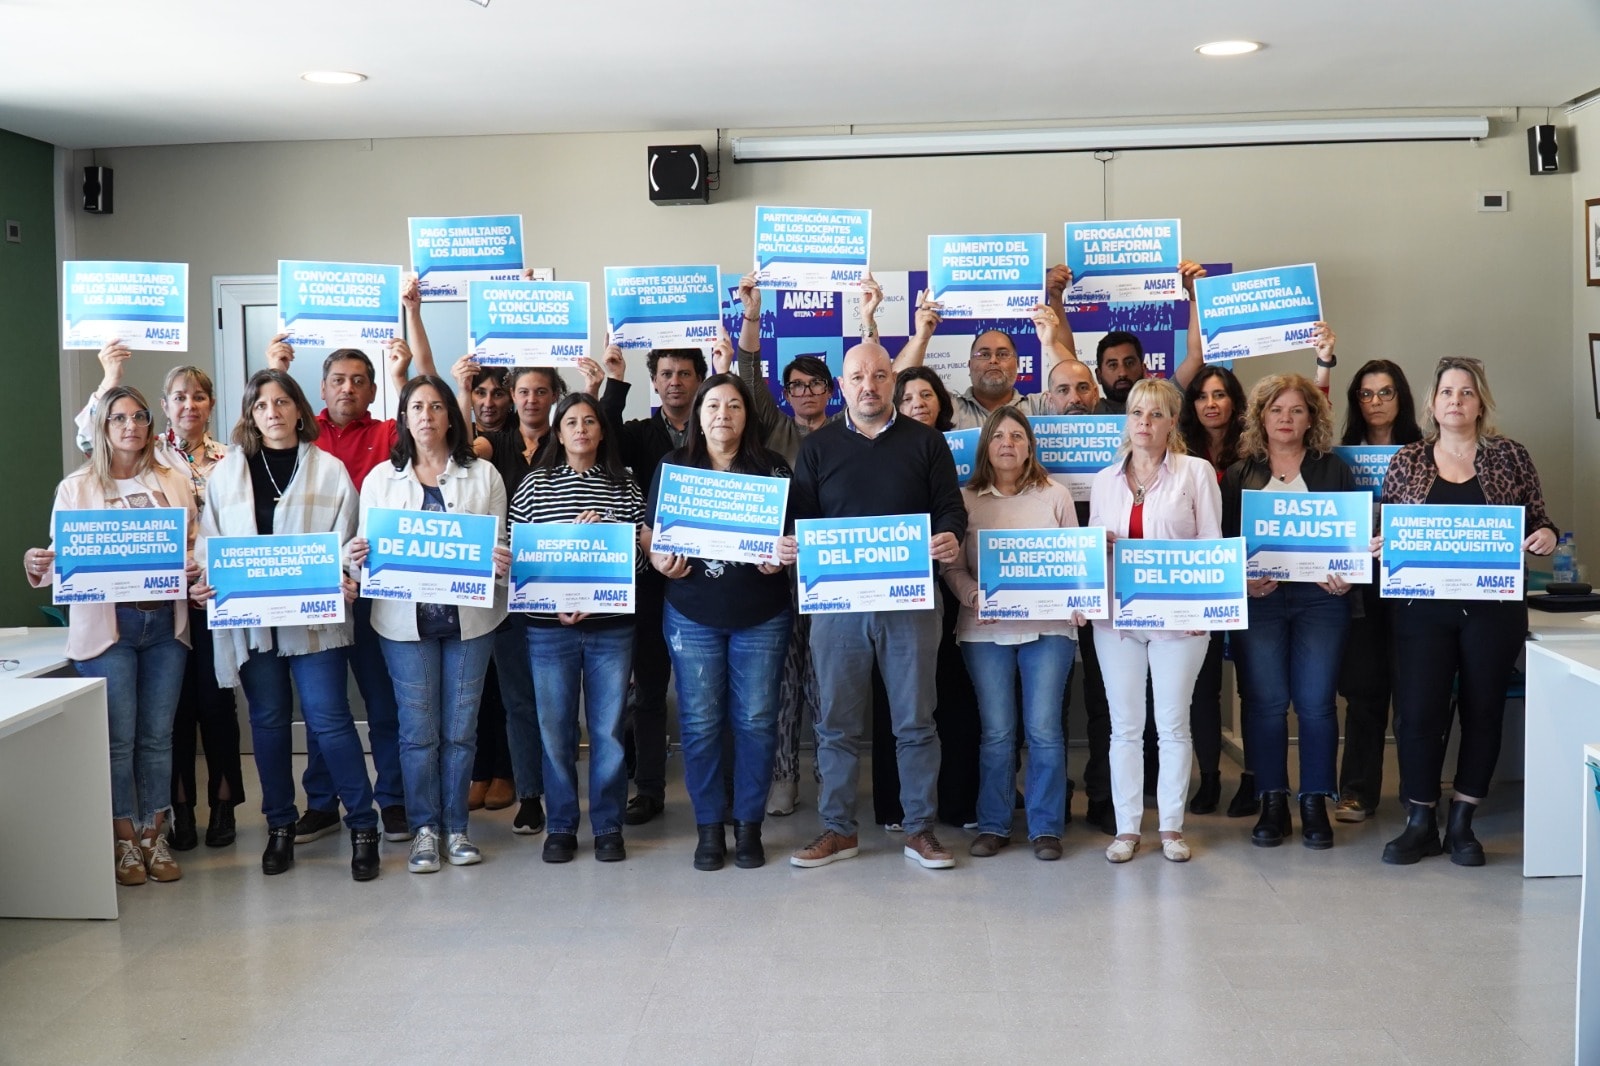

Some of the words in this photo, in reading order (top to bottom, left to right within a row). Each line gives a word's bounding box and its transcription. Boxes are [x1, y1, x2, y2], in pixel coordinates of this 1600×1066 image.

[763, 213, 830, 223] PARTICIPACIÓN
[831, 215, 862, 224] ACTIVA
[420, 228, 447, 238] PAGO
[448, 226, 511, 237] SIMULTANEO
[774, 224, 786, 232] DE
[787, 224, 803, 233] LOS
[805, 225, 851, 234] DOCENTES
[1074, 224, 1153, 240] DEROGACIÓN
[1155, 226, 1171, 238] DE
[417, 239, 430, 248] DE
[431, 238, 451, 247] LOS
[452, 236, 508, 246] AUMENTOS
[509, 236, 516, 245] A
[760, 233, 772, 242] EN
[774, 234, 784, 242] LA
[786, 233, 833, 244] DISCUSIÓN
[834, 236, 845, 244] DE
[847, 236, 864, 245] LAS
[1084, 242, 1100, 252] LA
[1102, 239, 1162, 251] REFORMA
[430, 249, 449, 257] LOS
[451, 247, 505, 256] JUBILADOS
[758, 242, 803, 253] POLÍTICAS
[804, 243, 865, 255] PEDAGÓGICAS
[944, 241, 1004, 254] AUMENTO
[1006, 241, 1028, 252] DEL
[942, 254, 1030, 267] PRESUPUESTO
[1084, 251, 1163, 265] JUBILATORIA
[76, 273, 104, 282] PAGO
[105, 274, 175, 284] SIMULTANEO
[293, 271, 386, 285] CONVOCATORIA
[617, 276, 660, 286] URGENTE
[661, 273, 707, 284] SOLUCIÓN
[831, 270, 862, 280] AMSAFE
[952, 269, 1020, 281] EDUCATIVO
[71, 284, 86, 293] DE
[86, 284, 106, 294] LOS
[107, 285, 169, 295] AUMENTOS
[170, 286, 179, 295] A
[299, 283, 308, 293] A
[309, 283, 381, 296] CONCURSOS
[611, 288, 618, 296] A
[619, 287, 636, 296] LAS
[638, 284, 714, 295] PROBLEMÁTICAS
[1144, 279, 1175, 290] AMSAFE
[1232, 277, 1281, 292] URGENTE
[84, 295, 103, 304] LOS
[105, 295, 165, 306] JUBILADOS
[299, 295, 308, 306] Y
[309, 295, 380, 307] TRASLADOS
[483, 290, 574, 300] CONVOCATORIA
[640, 296, 657, 305] DEL
[659, 295, 687, 303] IAPOS
[783, 291, 834, 309] AMSAFE
[1213, 288, 1293, 305] CONVOCATORIA
[1295, 286, 1303, 295] A
[488, 302, 497, 312] A
[499, 302, 569, 313] CONCURSOS
[1204, 304, 1259, 318] PARITARIA
[1261, 297, 1314, 311] NACIONAL
[489, 314, 498, 324] Y
[499, 314, 569, 325] TRASLADOS
[145, 328, 179, 339] AMSAFE
[361, 328, 394, 338] AMSAFE
[686, 326, 717, 337] AMSAFE
[551, 345, 583, 355] AMSAFE
[1033, 423, 1095, 435] AUMENTO
[1097, 422, 1120, 433] DEL
[1042, 451, 1112, 462] EDUCATIVO
[670, 472, 742, 489] PARTICIPACIÓN
[744, 482, 778, 493] ACTIVA
[681, 485, 694, 494] DE
[695, 486, 713, 496] LOS
[714, 489, 765, 502] DOCENTES
[664, 493, 678, 503] EN
[679, 496, 690, 505] LA
[693, 497, 745, 512] DISCUSIÓN
[746, 502, 759, 512] DE
[760, 504, 778, 514] LAS
[1274, 499, 1338, 516] BASTA
[661, 504, 710, 519] POLÍTICAS
[712, 510, 779, 525] PEDAGÓGICAS
[62, 521, 120, 532] AUMENTO
[122, 520, 178, 531] SALARIAL
[398, 517, 463, 538] BASTA
[1255, 520, 1280, 536] DE
[1283, 521, 1356, 538] AJUSTE
[1391, 517, 1452, 527] AUMENTO
[1454, 518, 1515, 529] SALARIAL
[70, 534, 94, 546] QUE
[96, 533, 154, 544] RECUPERE
[156, 532, 170, 541] EL
[805, 522, 921, 546] RESTITUCIÓN
[1399, 529, 1424, 541] QUE
[1426, 529, 1490, 540] RECUPERE
[1492, 530, 1506, 540] EL
[537, 540, 590, 550] RESPETO
[592, 540, 608, 550] AL
[739, 540, 774, 553] AMSAFE
[989, 534, 1076, 550] DEROGACIÓN
[1078, 536, 1096, 548] DE
[1390, 540, 1431, 551] PODER
[1434, 541, 1514, 554] ADQUISITIVO
[62, 545, 102, 556] PODER
[104, 543, 178, 557] ADQUISITIVO
[221, 547, 271, 557] URGENTE
[273, 543, 326, 556] SOLUCIÓN
[378, 538, 404, 555] DE
[407, 540, 481, 561] AJUSTE
[517, 549, 563, 562] ÁMBITO
[564, 552, 628, 563] PARITARIO
[819, 548, 852, 565] DEL
[855, 546, 910, 564] FONID
[1122, 545, 1237, 565] RESTITUCIÓN
[214, 559, 222, 568] A
[224, 559, 244, 568] LAS
[246, 554, 334, 567] PROBLEMÁTICAS
[1000, 552, 1017, 563] LA
[1020, 550, 1087, 563] REFORMA
[999, 564, 1088, 577] JUBILATORIA
[1329, 559, 1364, 570] AMSAFE
[248, 568, 268, 578] DEL
[270, 567, 302, 577] IAPOS
[1135, 568, 1168, 584] DEL
[1170, 568, 1224, 584] FONID
[144, 576, 180, 588] AMSAFE
[451, 581, 486, 595] AMSAFE
[1477, 576, 1515, 588] AMSAFE
[594, 590, 628, 601] AMSAFE
[890, 584, 925, 597] AMSAFE
[301, 600, 336, 614] AMSAFE
[1067, 596, 1101, 608] AMSAFE
[1204, 606, 1240, 618] AMSAFE
